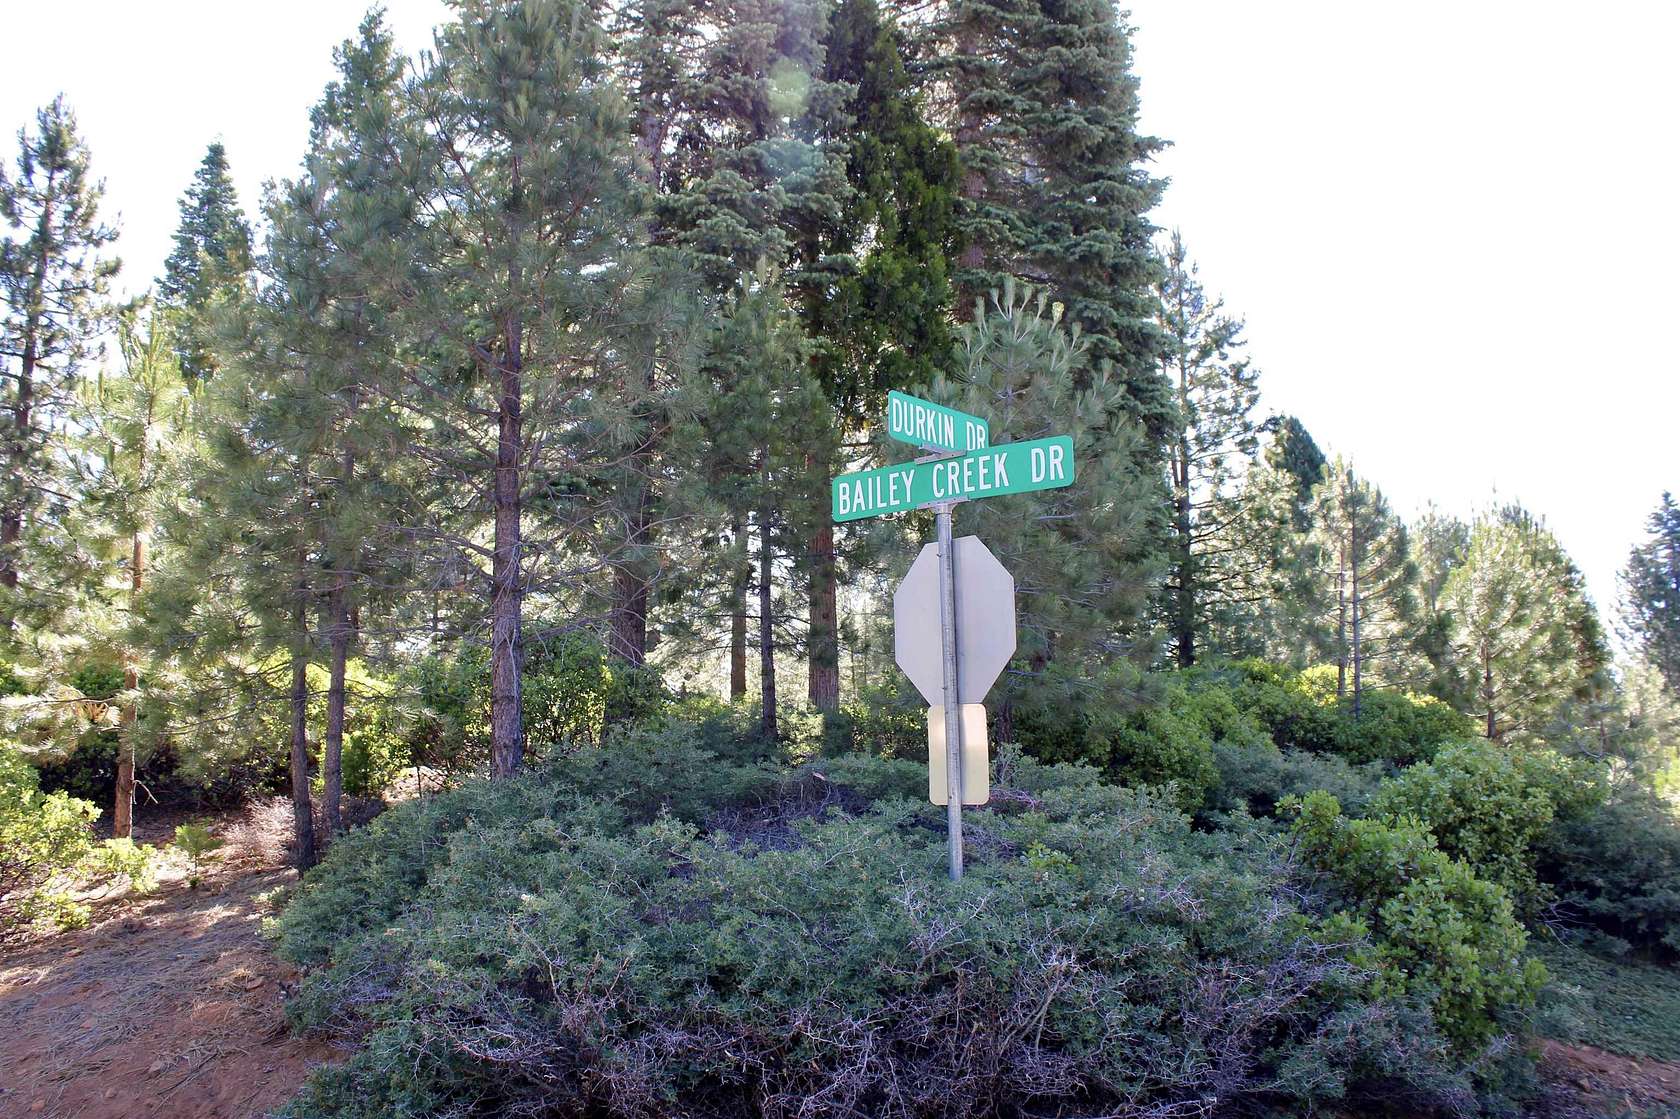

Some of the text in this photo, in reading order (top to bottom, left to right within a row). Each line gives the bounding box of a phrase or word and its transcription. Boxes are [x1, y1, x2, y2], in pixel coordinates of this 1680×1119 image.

[892, 399, 986, 450] DURKIN DR
[839, 445, 1065, 515] BAILEY CREEK DR
